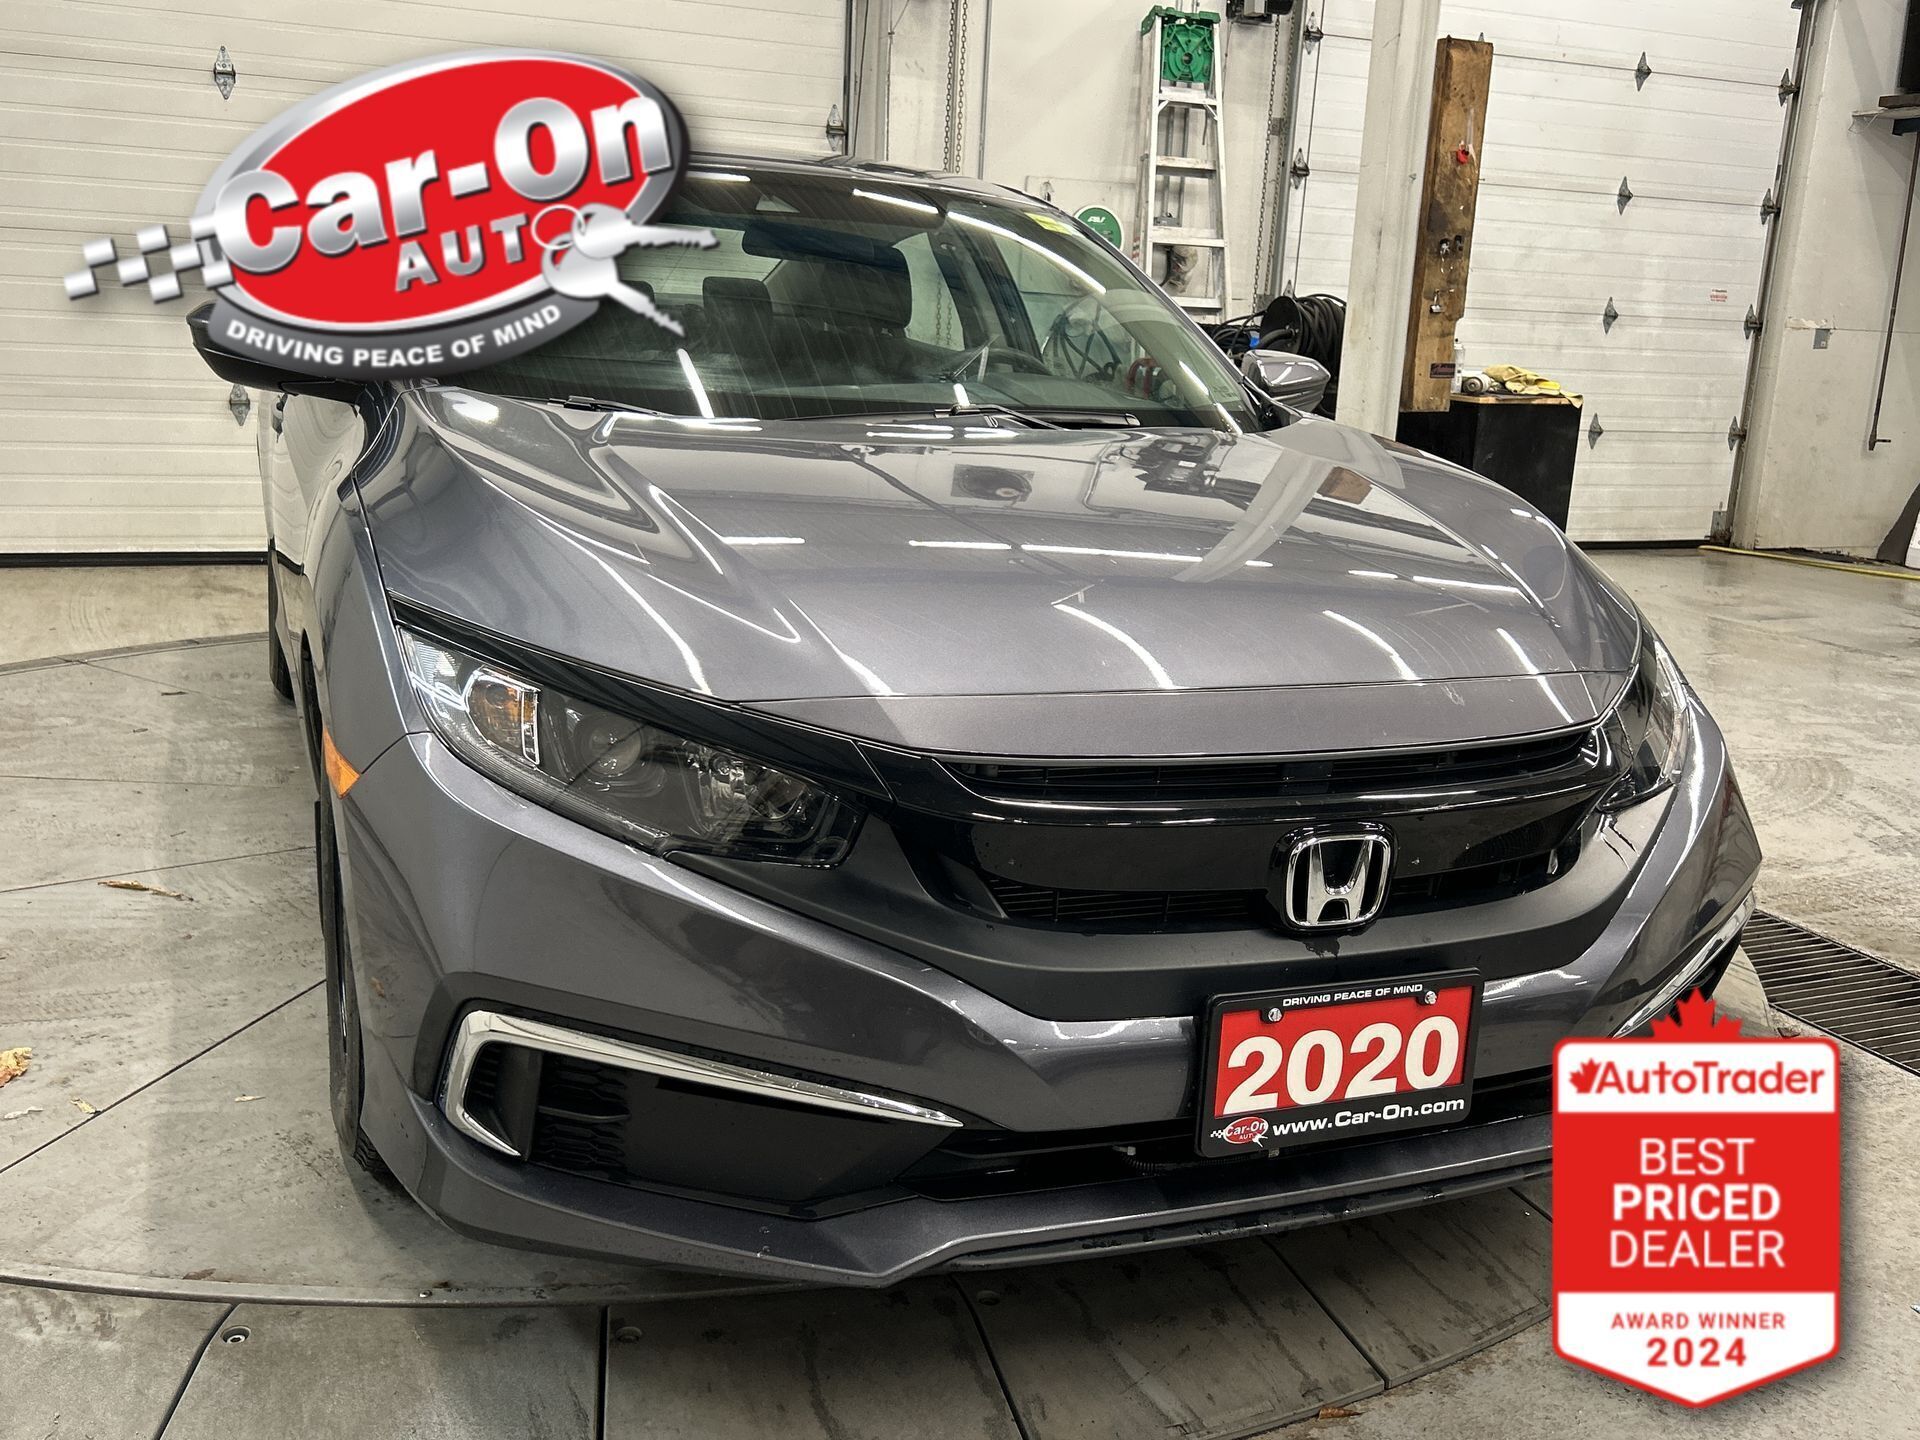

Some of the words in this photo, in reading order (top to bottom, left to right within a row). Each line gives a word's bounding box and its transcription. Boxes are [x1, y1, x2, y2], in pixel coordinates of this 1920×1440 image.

[1283, 994, 1331, 1007] DRIVING
[1334, 989, 1372, 1001] PEACE
[1375, 987, 1391, 997] OF
[1393, 984, 1423, 995] MIND
[1223, 1015, 1459, 1114] 2020
[1225, 1120, 1267, 1137] Car-On
[1273, 1099, 1465, 1137] www.Car-On.com
